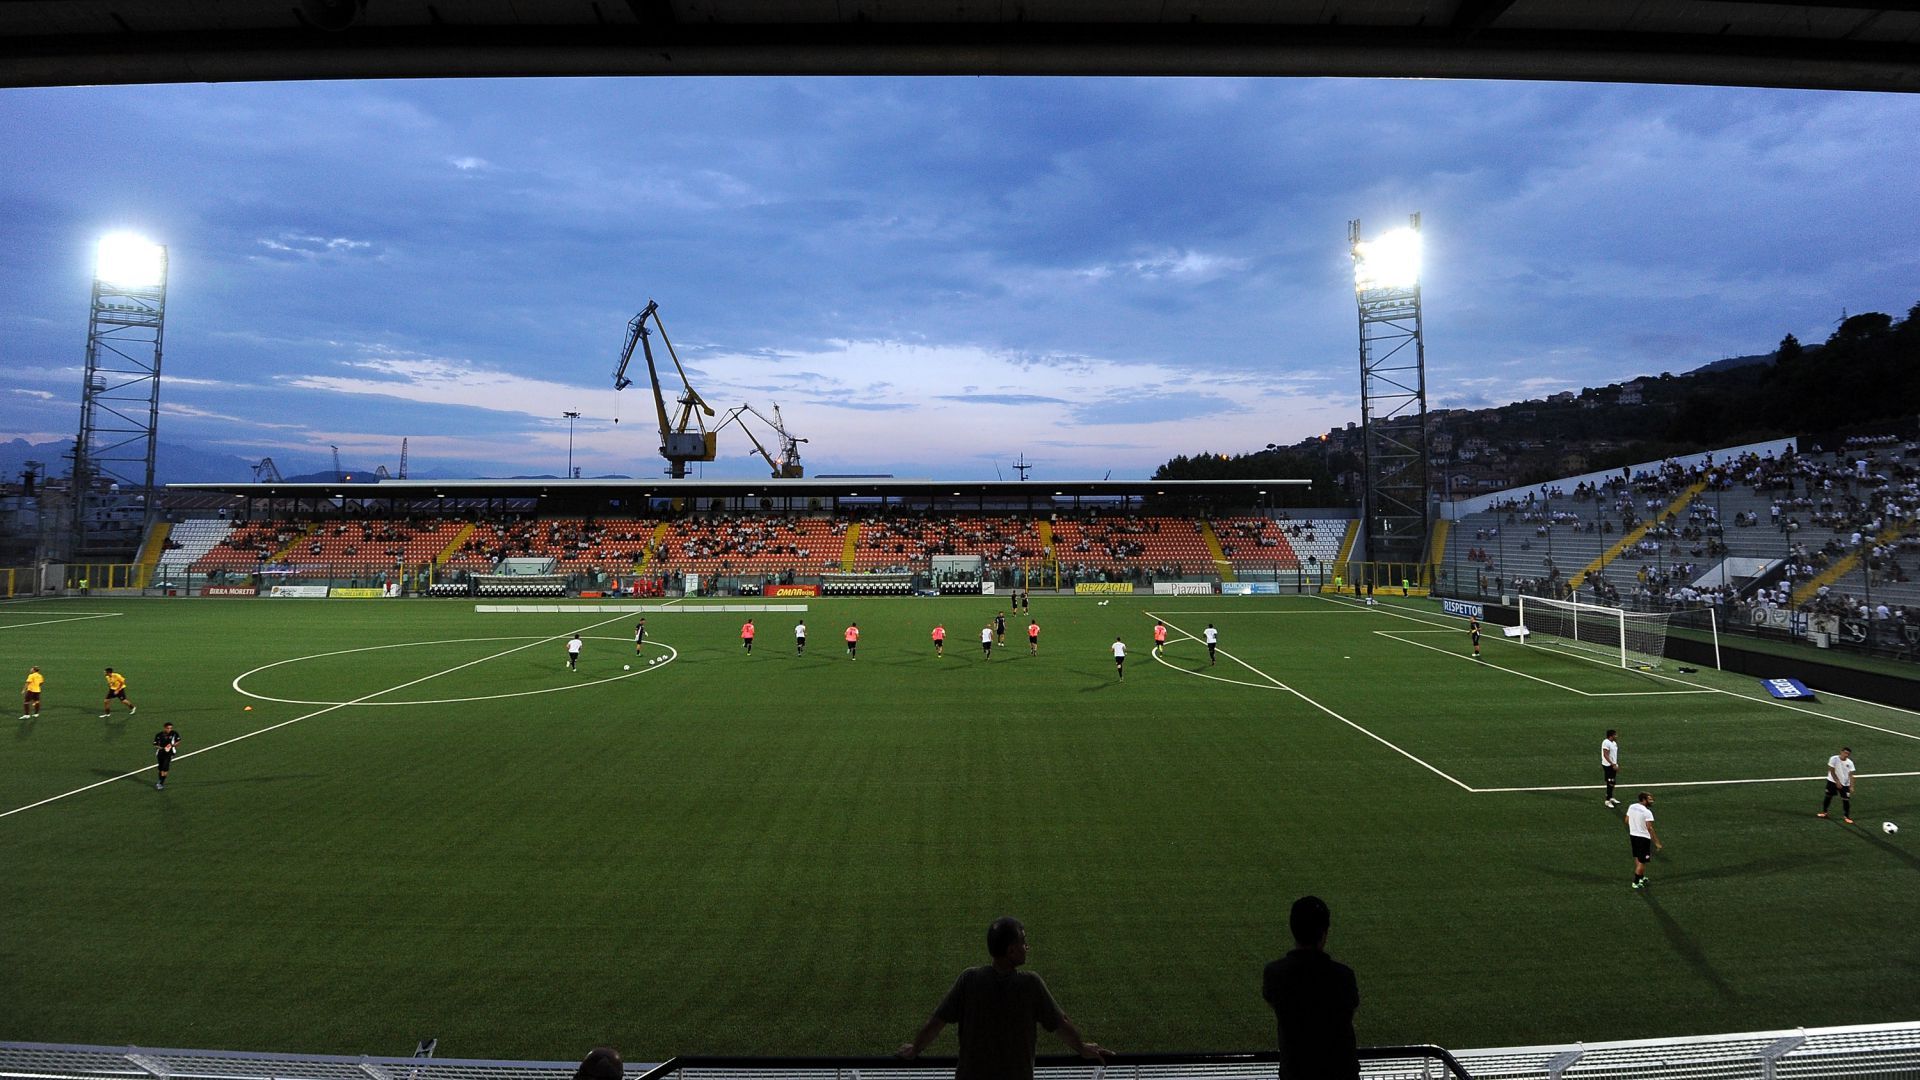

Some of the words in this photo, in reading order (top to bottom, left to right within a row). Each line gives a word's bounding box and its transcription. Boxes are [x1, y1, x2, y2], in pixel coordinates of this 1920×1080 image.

[1081, 583, 1130, 592] REZZAGHI
[1171, 583, 1210, 594] Piazzini
[1444, 600, 1478, 616] RISPETTO
